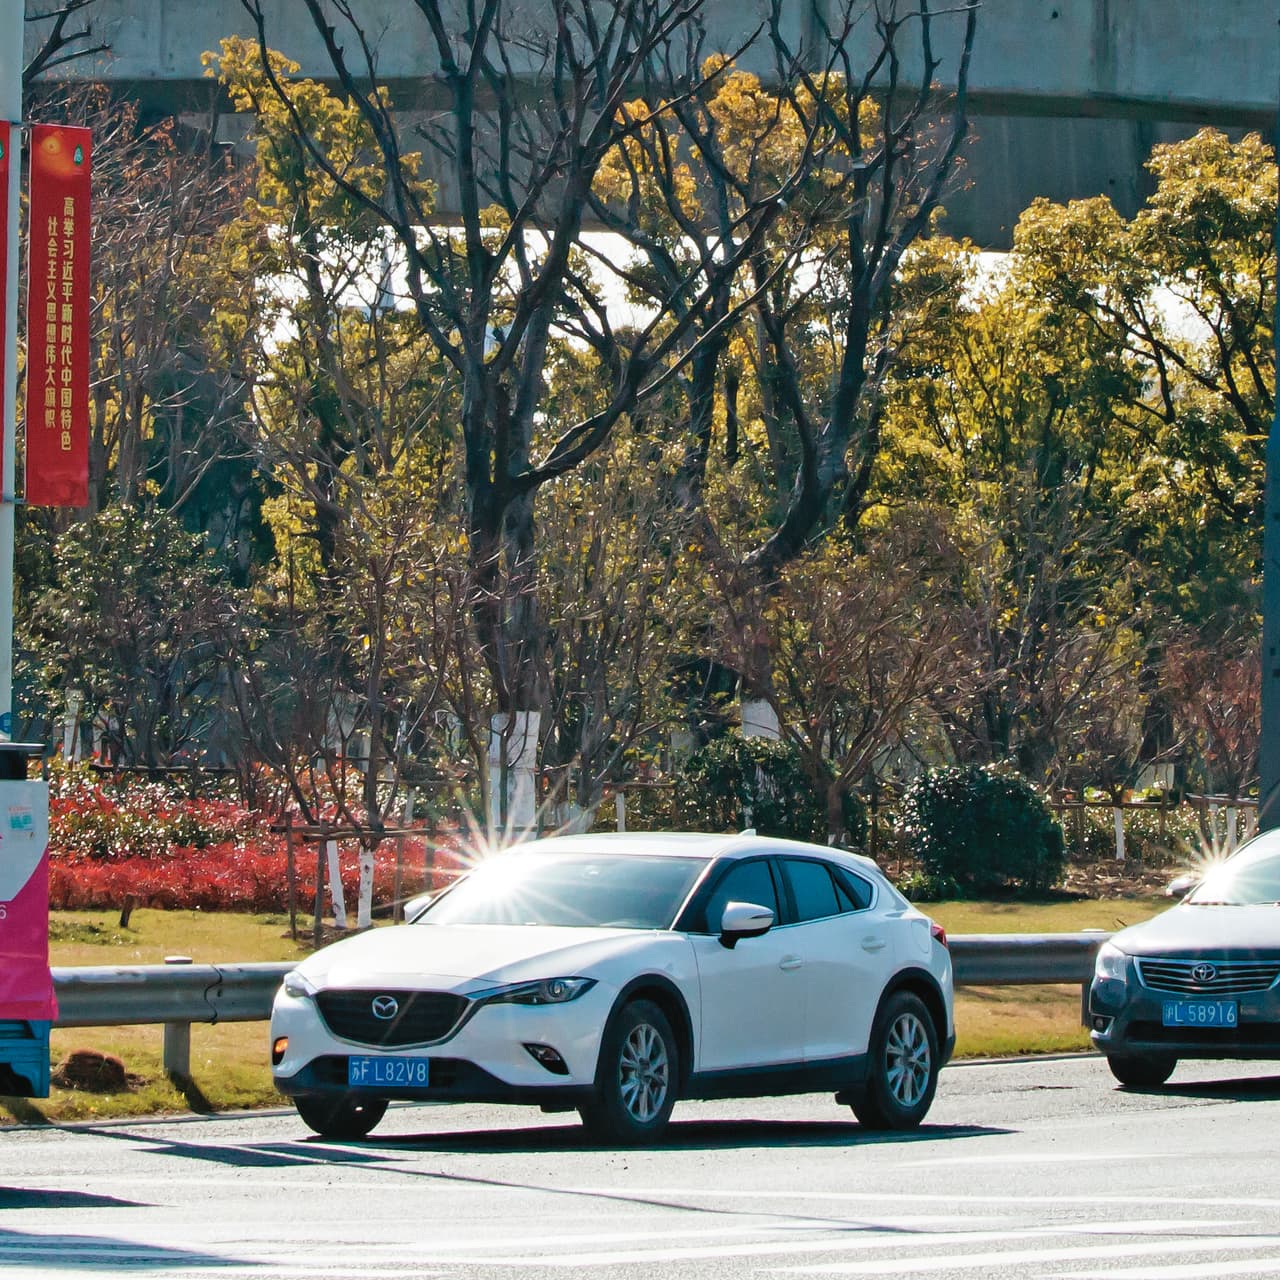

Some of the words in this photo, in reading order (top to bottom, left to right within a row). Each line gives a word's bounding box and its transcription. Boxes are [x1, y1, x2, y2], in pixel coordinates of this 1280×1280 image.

[44, 216, 58, 429] 社会主义思想伟大旗帜
[61, 196, 75, 451] 高举习近平新时代中国特色
